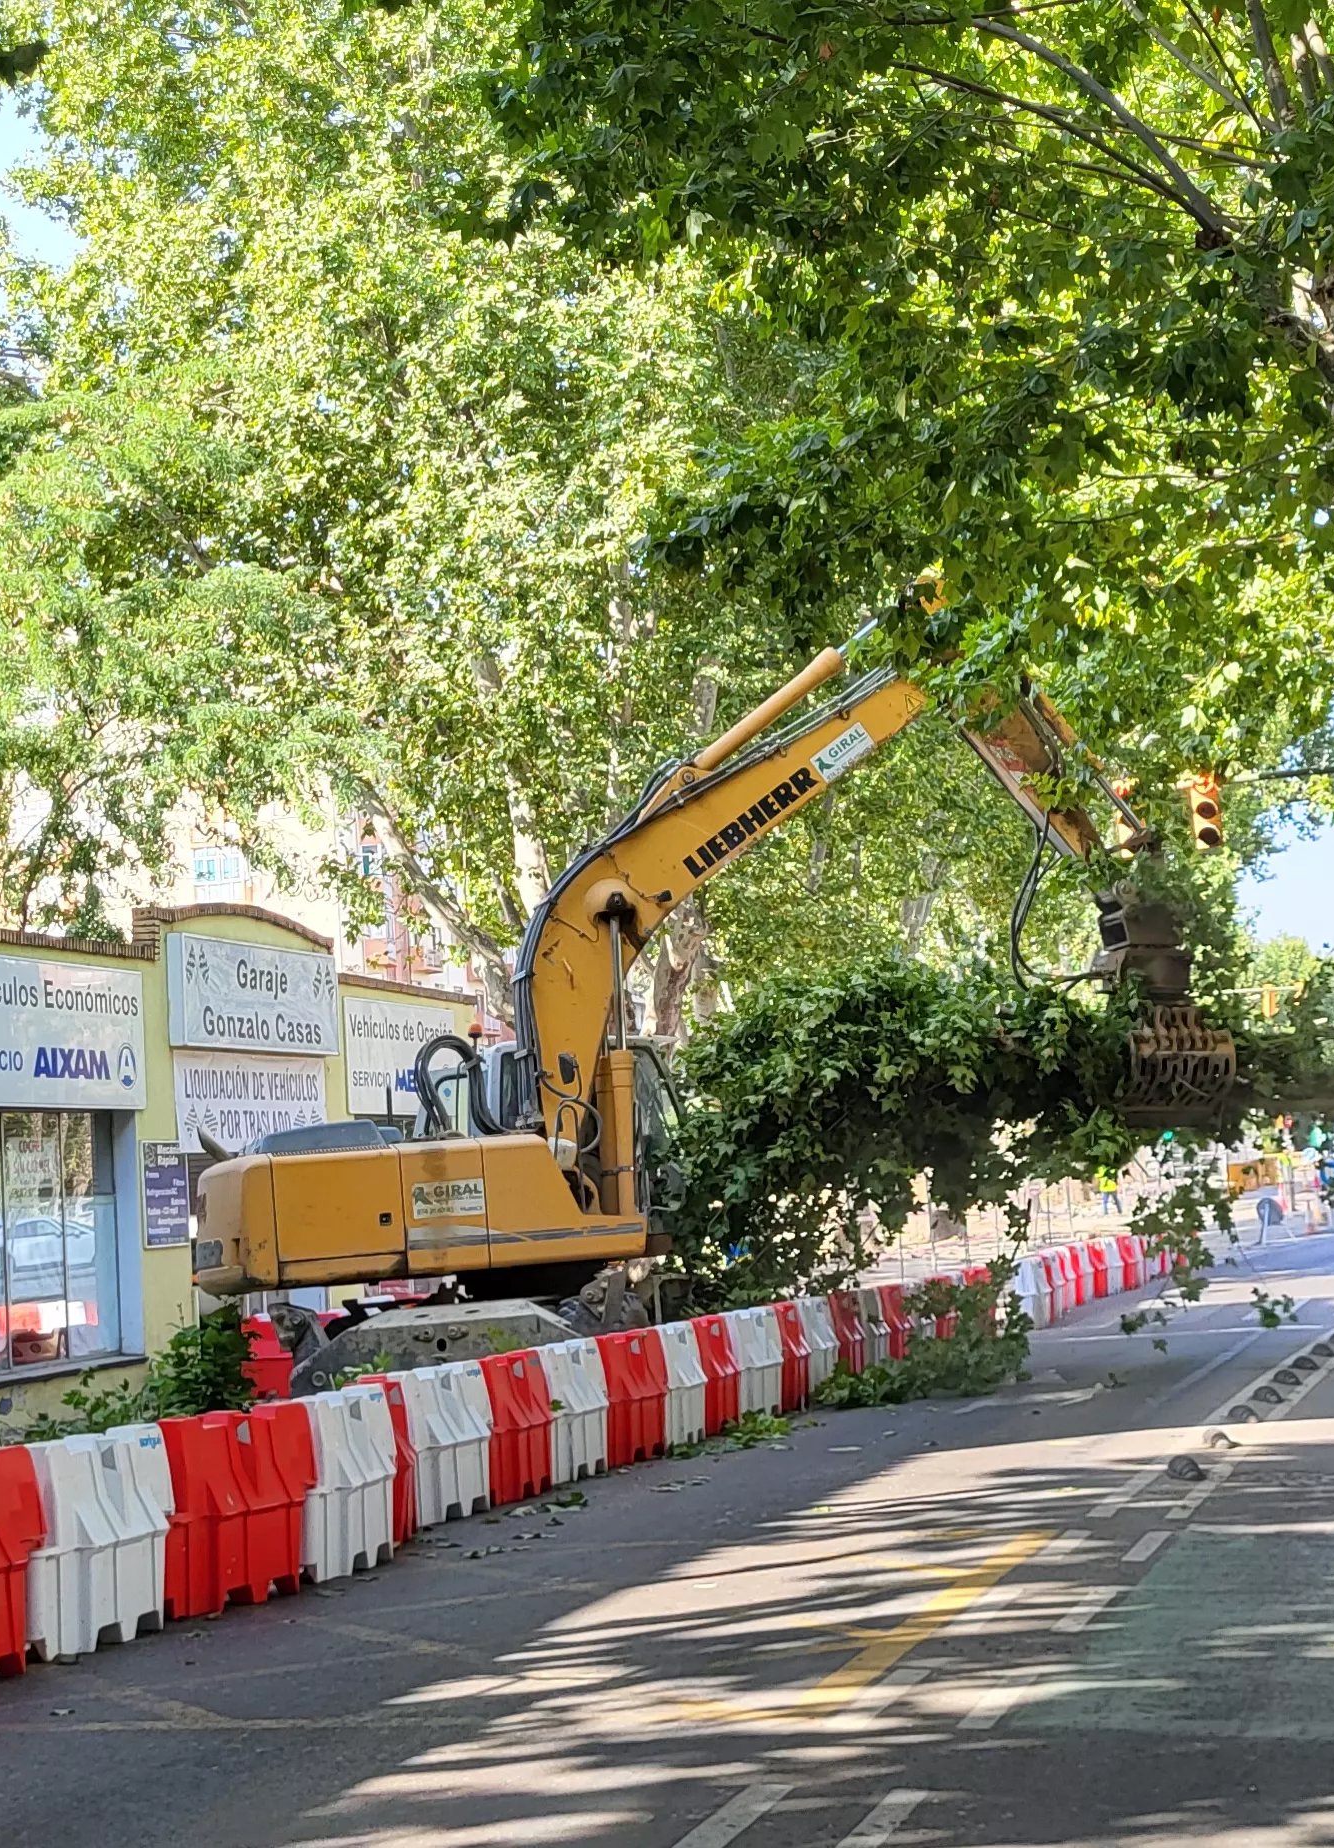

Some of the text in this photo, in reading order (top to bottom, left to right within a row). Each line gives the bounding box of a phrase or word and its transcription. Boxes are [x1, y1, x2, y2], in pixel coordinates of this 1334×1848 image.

[828, 729, 866, 758] GIRAL
[682, 767, 819, 880] LIEBHERR
[236, 958, 288, 1000] Garaje
[43, 979, 139, 1017] Económicos
[202, 1005, 322, 1045] Gonzalo Casas
[349, 1013, 400, 1040] Vehículos
[403, 1020, 415, 1042] de
[33, 1046, 112, 1081] AIXAM
[352, 1070, 392, 1088] SERVICIO
[183, 1065, 319, 1101] LIQUIDACIÓN DE VEHÍCULOS
[220, 1109, 243, 1139] POR
[433, 1183, 483, 1198] GIRAL
